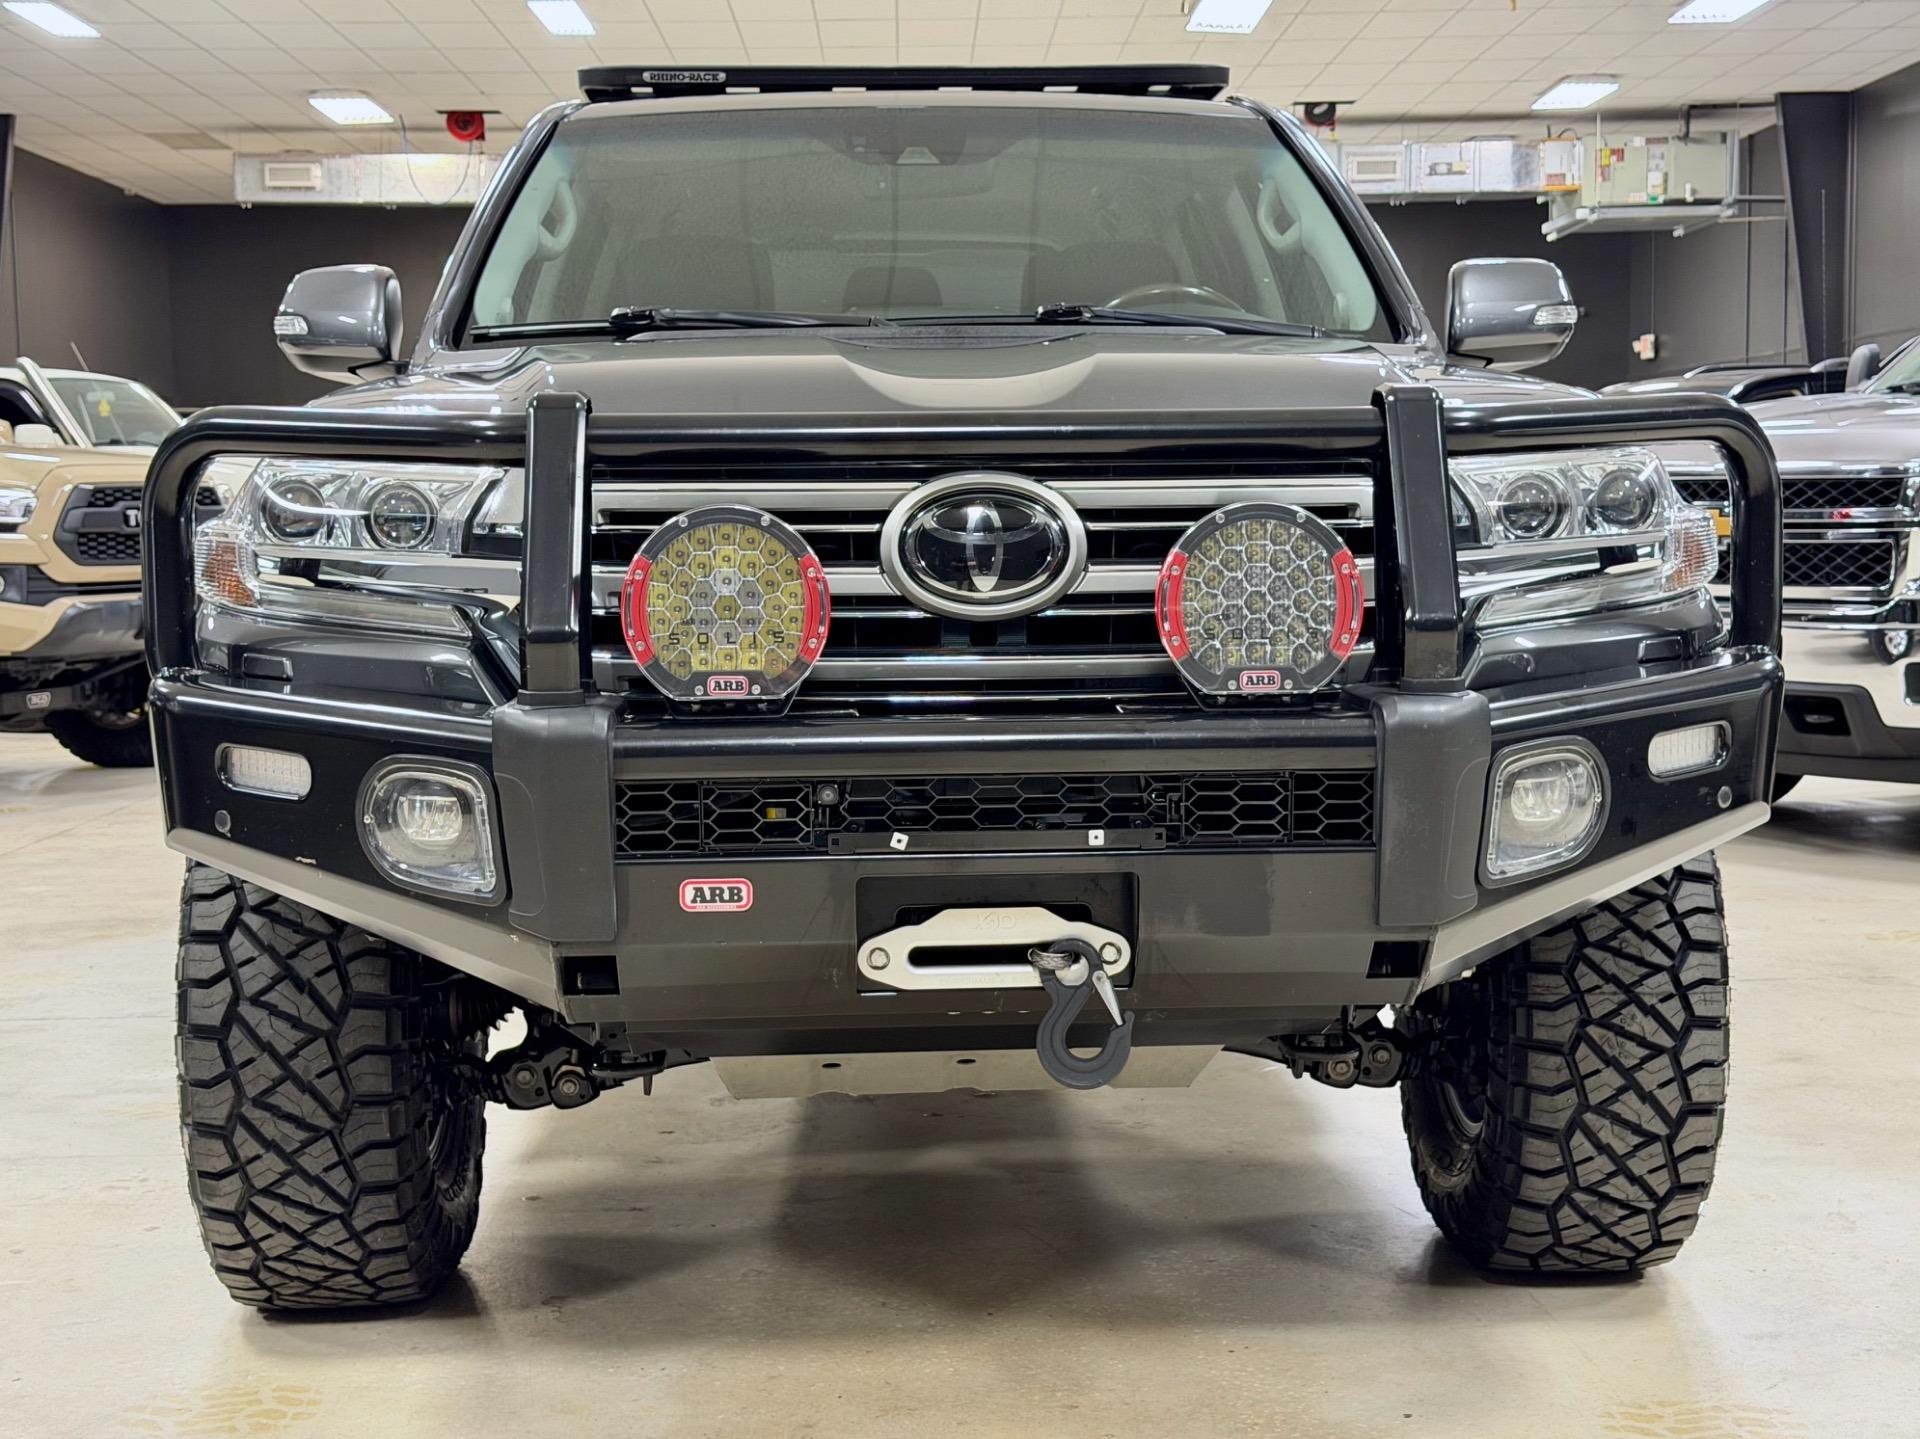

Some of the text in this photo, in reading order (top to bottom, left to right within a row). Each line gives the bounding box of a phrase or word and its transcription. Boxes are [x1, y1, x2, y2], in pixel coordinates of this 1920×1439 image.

[649, 71, 719, 82] RHINO-RACK
[668, 631, 785, 645] SOLIS
[712, 680, 744, 692] ARB
[1245, 674, 1276, 686] ARB
[690, 886, 744, 904] ARB
